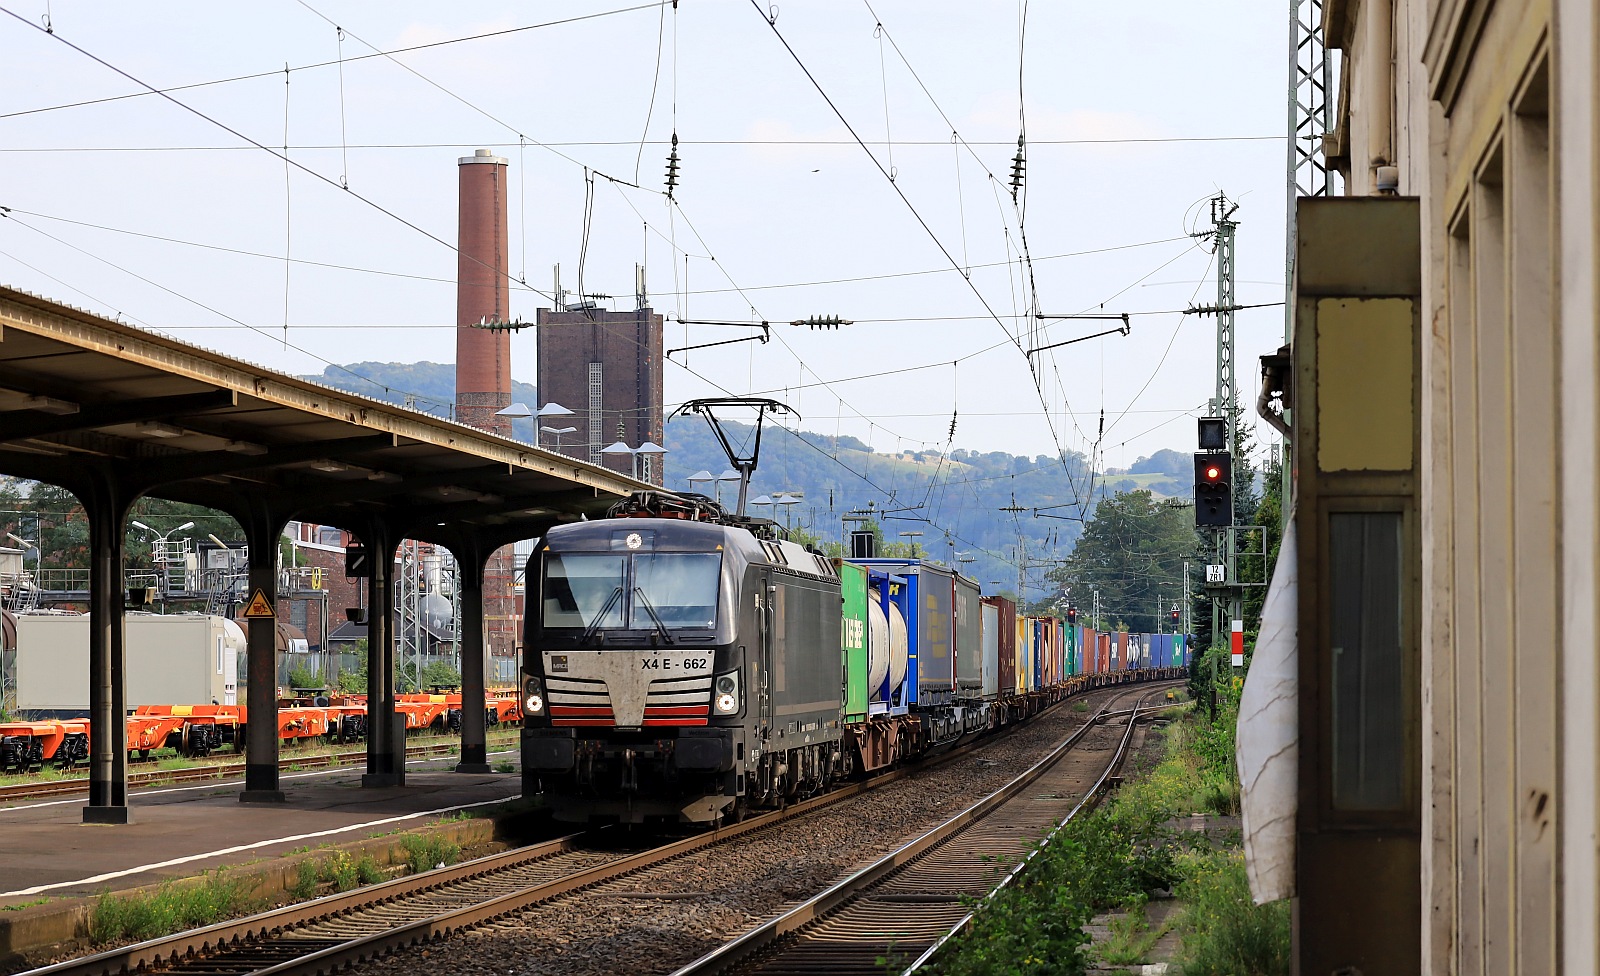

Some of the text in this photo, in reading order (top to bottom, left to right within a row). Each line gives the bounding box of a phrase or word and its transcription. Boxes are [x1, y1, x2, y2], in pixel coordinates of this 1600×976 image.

[1212, 566, 1218, 574] 12
[1210, 574, 1222, 582] ZR1
[642, 658, 659, 670] X4
[663, 658, 671, 670] E
[684, 658, 707, 670] 662
